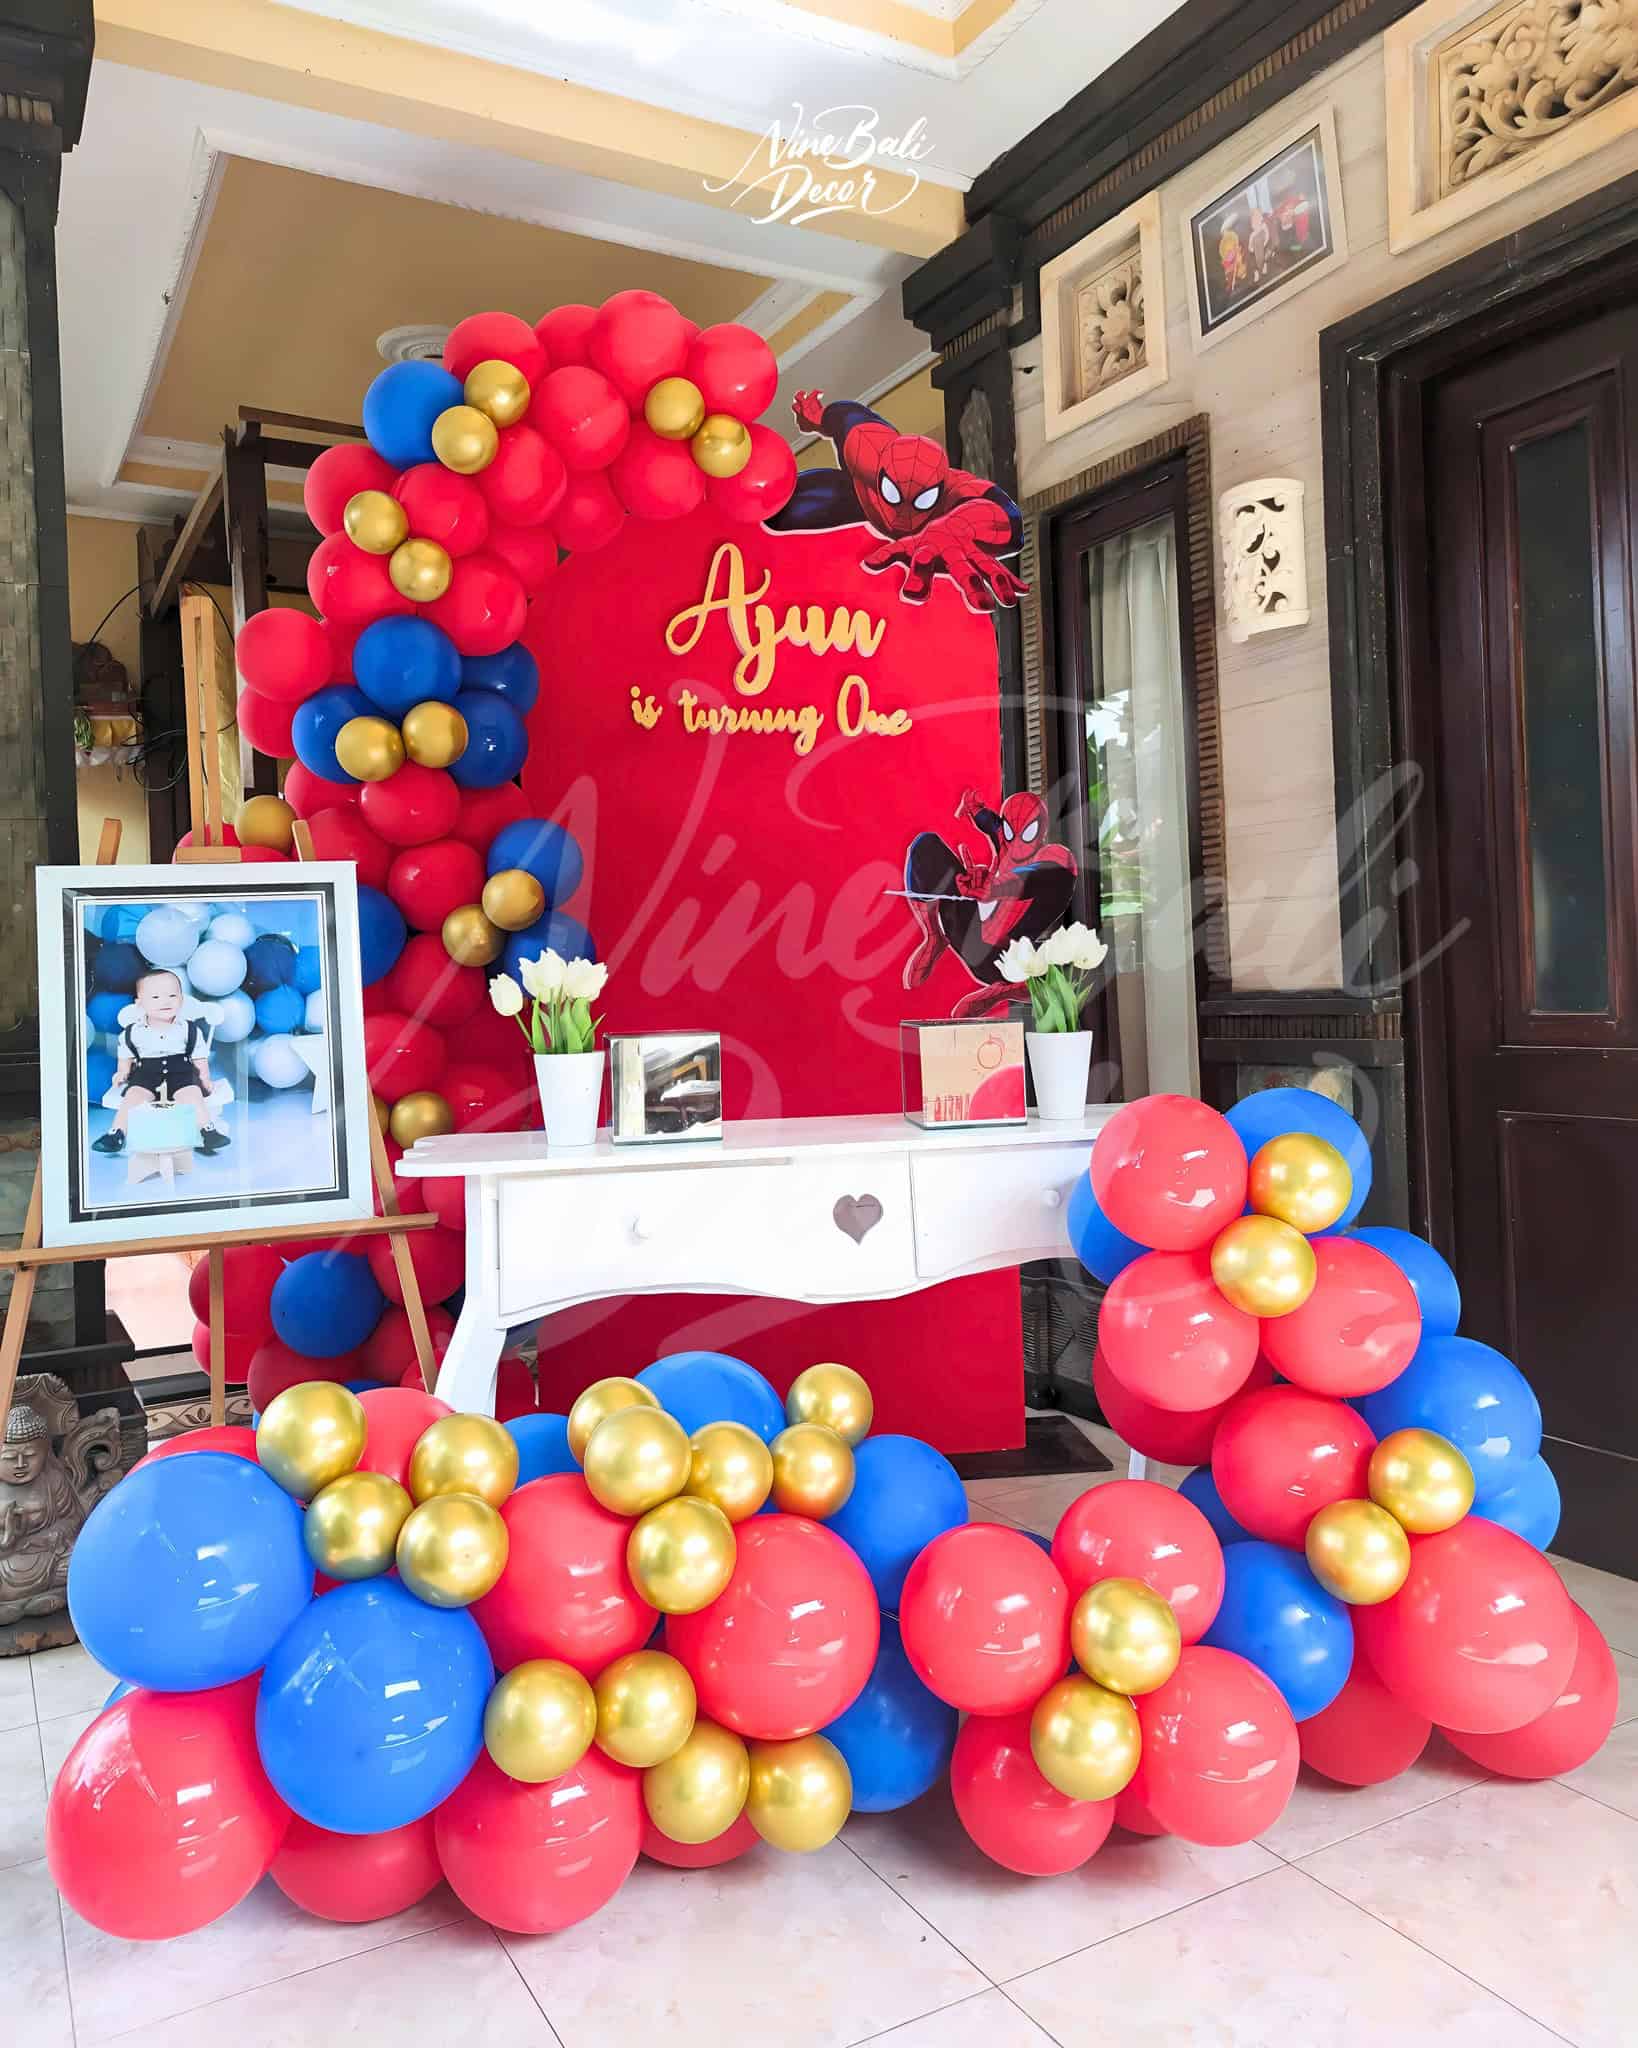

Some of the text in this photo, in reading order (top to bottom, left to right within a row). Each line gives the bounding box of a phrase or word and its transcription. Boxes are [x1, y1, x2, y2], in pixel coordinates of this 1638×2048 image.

[630, 675, 913, 756] is turning One
